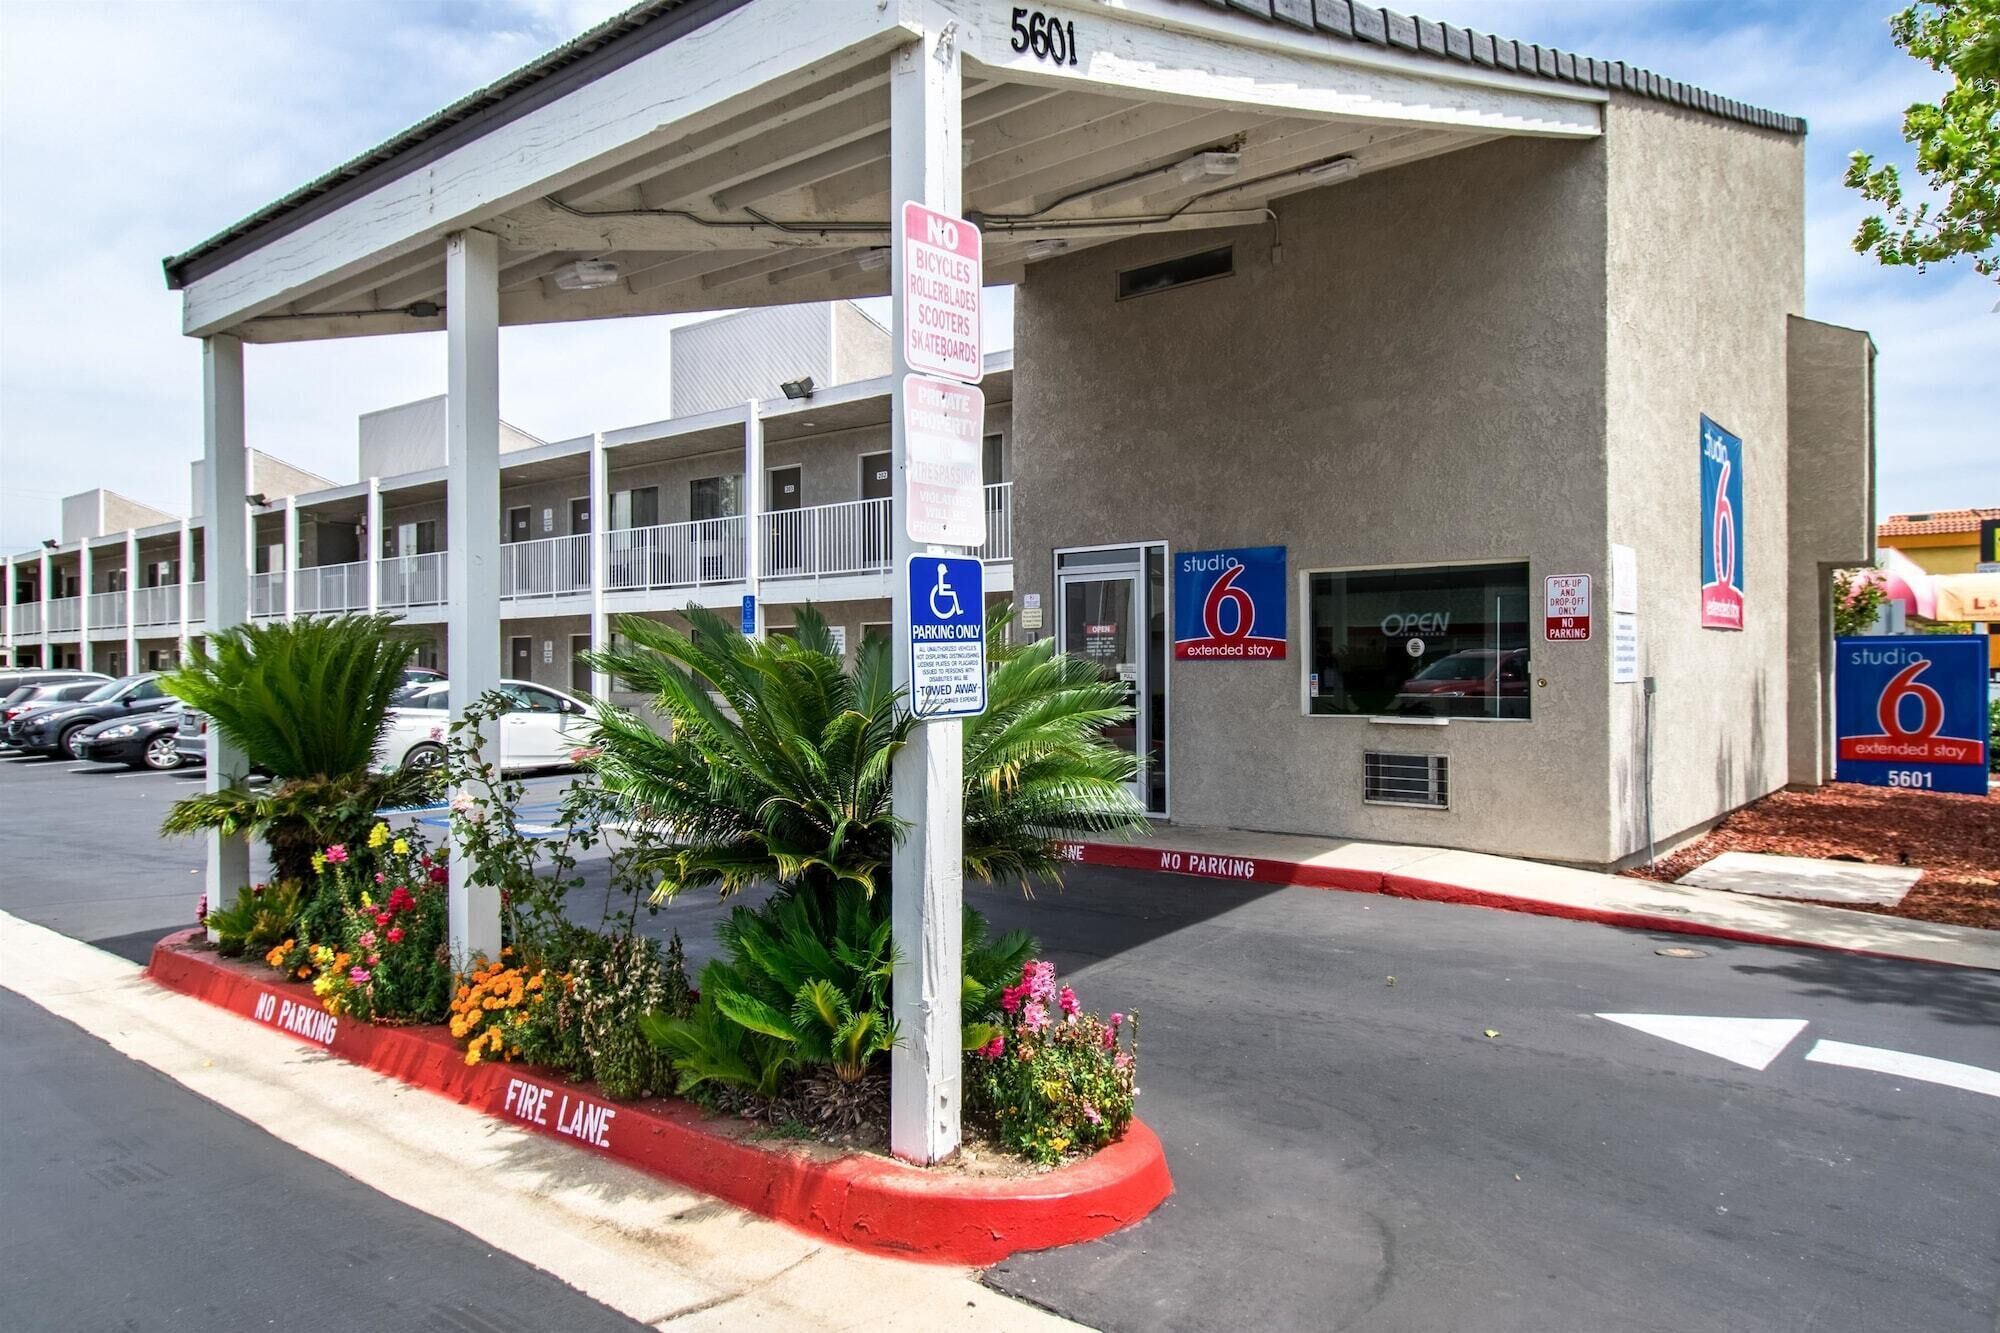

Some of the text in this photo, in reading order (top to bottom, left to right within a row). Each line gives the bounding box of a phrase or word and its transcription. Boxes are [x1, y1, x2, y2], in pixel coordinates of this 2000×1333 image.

[1011, 7, 1078, 66] 5601
[926, 214, 959, 251] NO
[916, 248, 970, 284] BICYCLES
[910, 274, 976, 313] ROLLERBLADES
[918, 303, 970, 337] SCOOTERS
[911, 329, 977, 365] SKATEBOARDS
[918, 386, 970, 413] PRIVATE
[910, 409, 977, 437] PROPERTY
[1713, 460, 1735, 587] 6
[1184, 554, 1238, 572] studio
[1553, 579, 1582, 588] PICK-UP
[1560, 589, 1575, 597] AND
[1203, 564, 1255, 639] 6
[1550, 597, 1584, 606] DROP-OFF
[1559, 607, 1577, 615] ONLY
[913, 624, 981, 639] PARKING ONLY
[1092, 625, 1111, 633] OPEN
[1381, 612, 1449, 636] OPEN
[1550, 629, 1586, 638] PARKING
[1562, 618, 1574, 628] NO
[1187, 643, 1273, 658] extended stay
[1851, 648, 1924, 665] studio
[1877, 659, 1945, 737] 6
[1855, 743, 1967, 760] extended stay
[1888, 770, 1932, 787] 5601
[1161, 852, 1254, 879] NO PARKING
[254, 992, 338, 1045] NO PARKING
[504, 1078, 616, 1148] FIRE LANE
